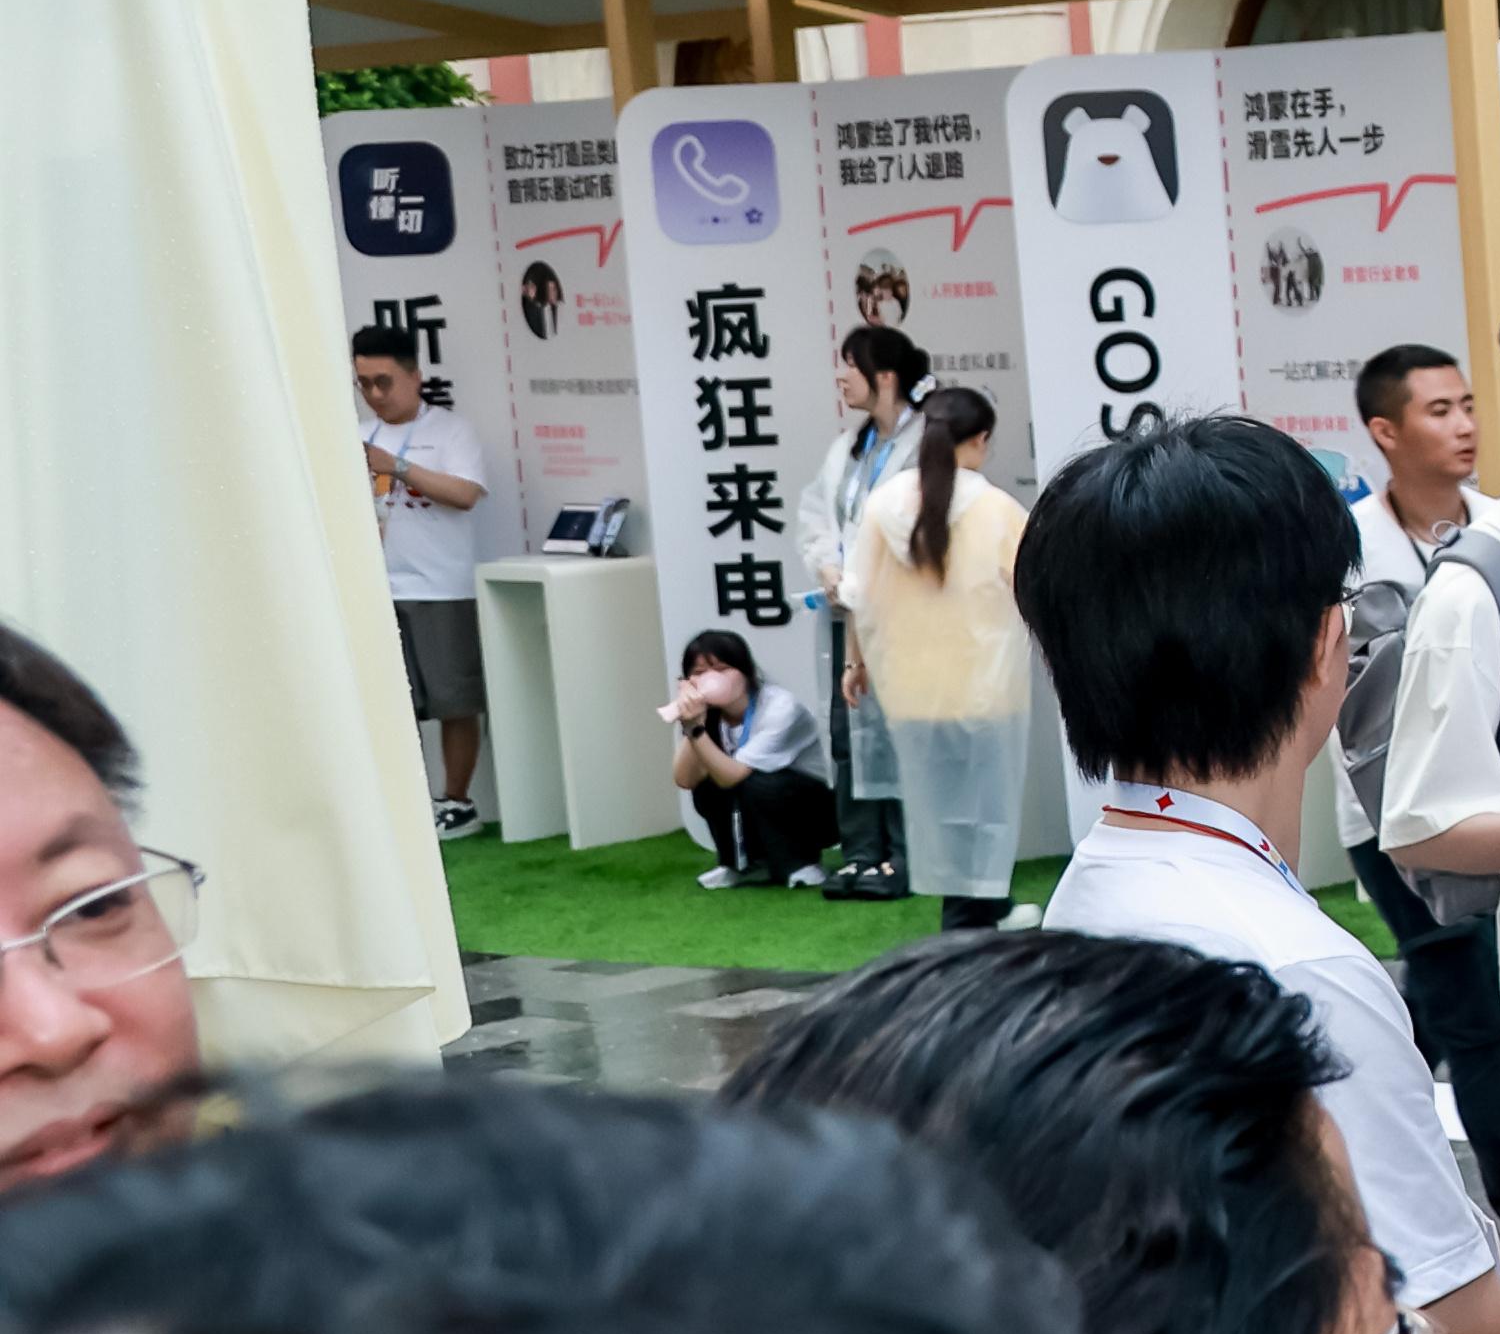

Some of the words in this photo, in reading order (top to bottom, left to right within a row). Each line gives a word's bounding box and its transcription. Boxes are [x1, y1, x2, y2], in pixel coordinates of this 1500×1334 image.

[1245, 87, 1346, 122] 鸿蒙在手，
[1248, 122, 1385, 160] 滑雪先人一步
[685, 283, 792, 627] 疯狂来电
